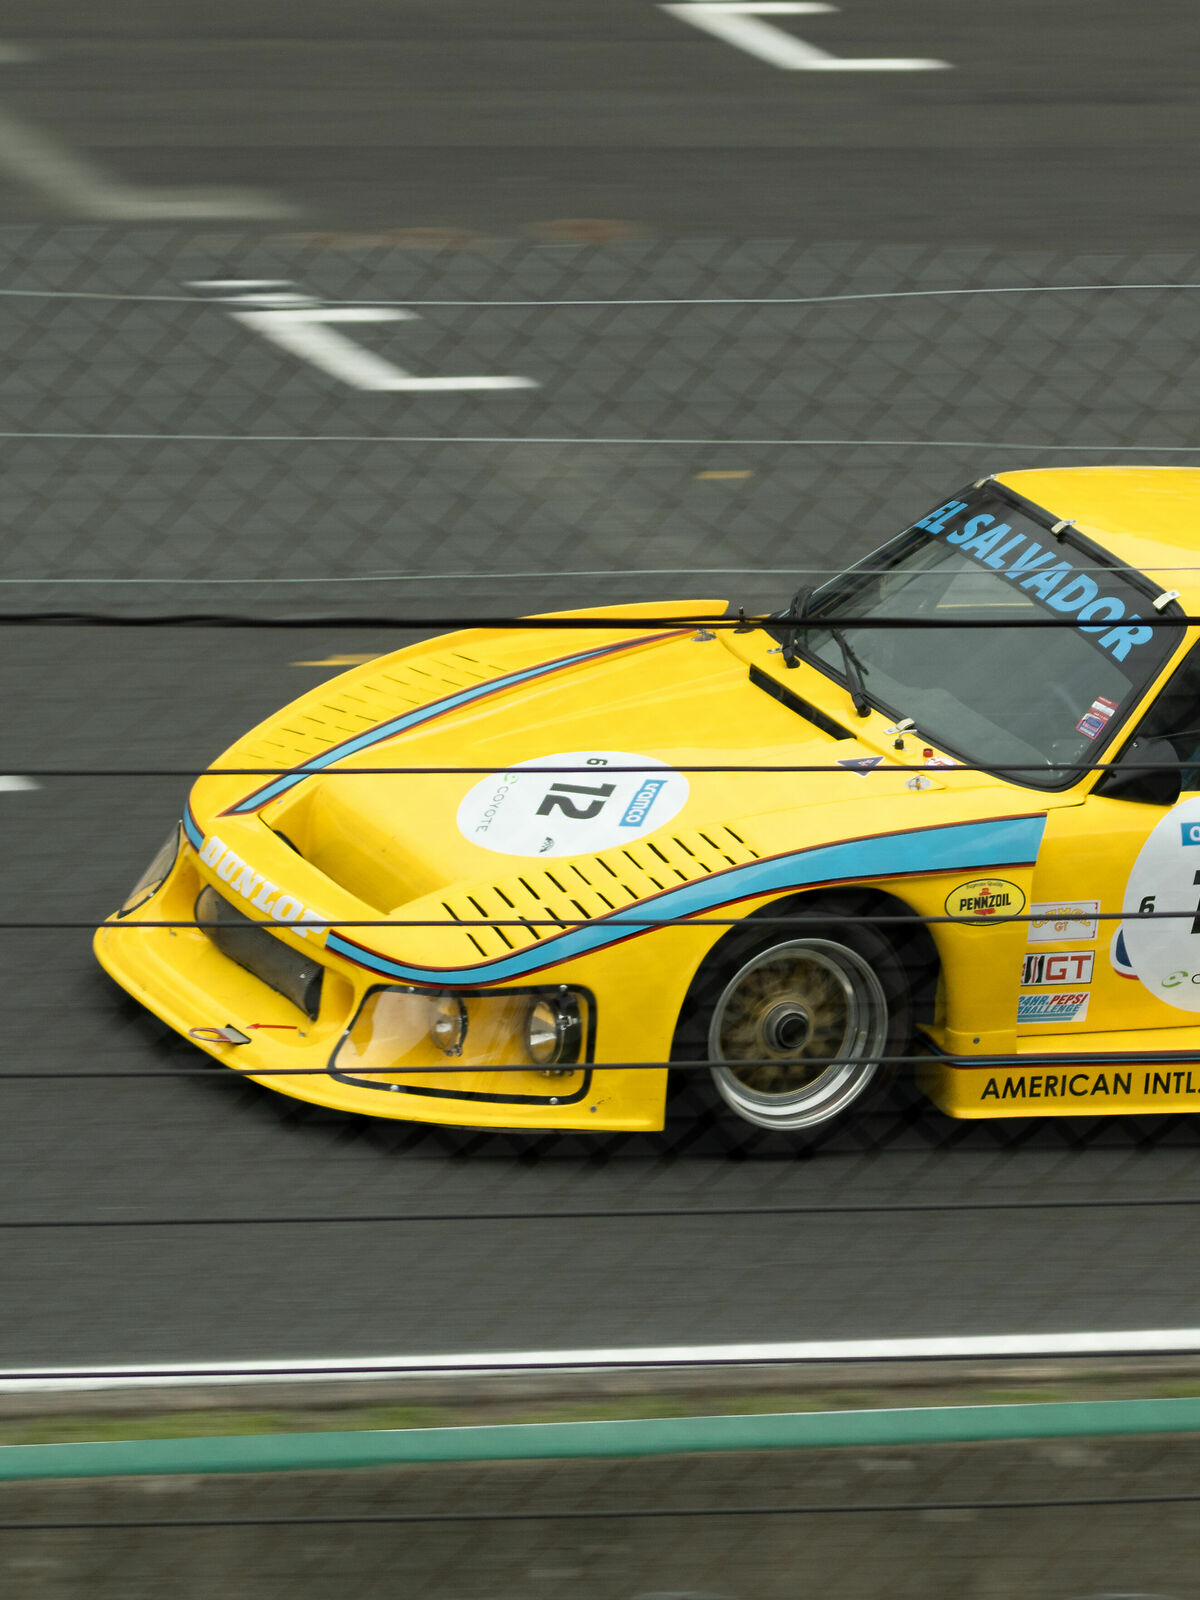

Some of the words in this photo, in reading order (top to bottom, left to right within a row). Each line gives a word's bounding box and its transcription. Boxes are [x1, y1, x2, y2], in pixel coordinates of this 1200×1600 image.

[913, 500, 969, 535] EL
[946, 513, 1154, 662] SALVADOR
[475, 785, 509, 833] COYOTE
[535, 783, 617, 819] 12
[199, 836, 331, 938] DUNLOP
[960, 893, 1011, 911] PENNZOIL
[1138, 895, 1156, 918] 6
[1054, 921, 1069, 932] GT
[1046, 955, 1092, 981] GT
[1049, 993, 1089, 1006] PEPSI
[980, 1073, 1132, 1100] AMERICAN
